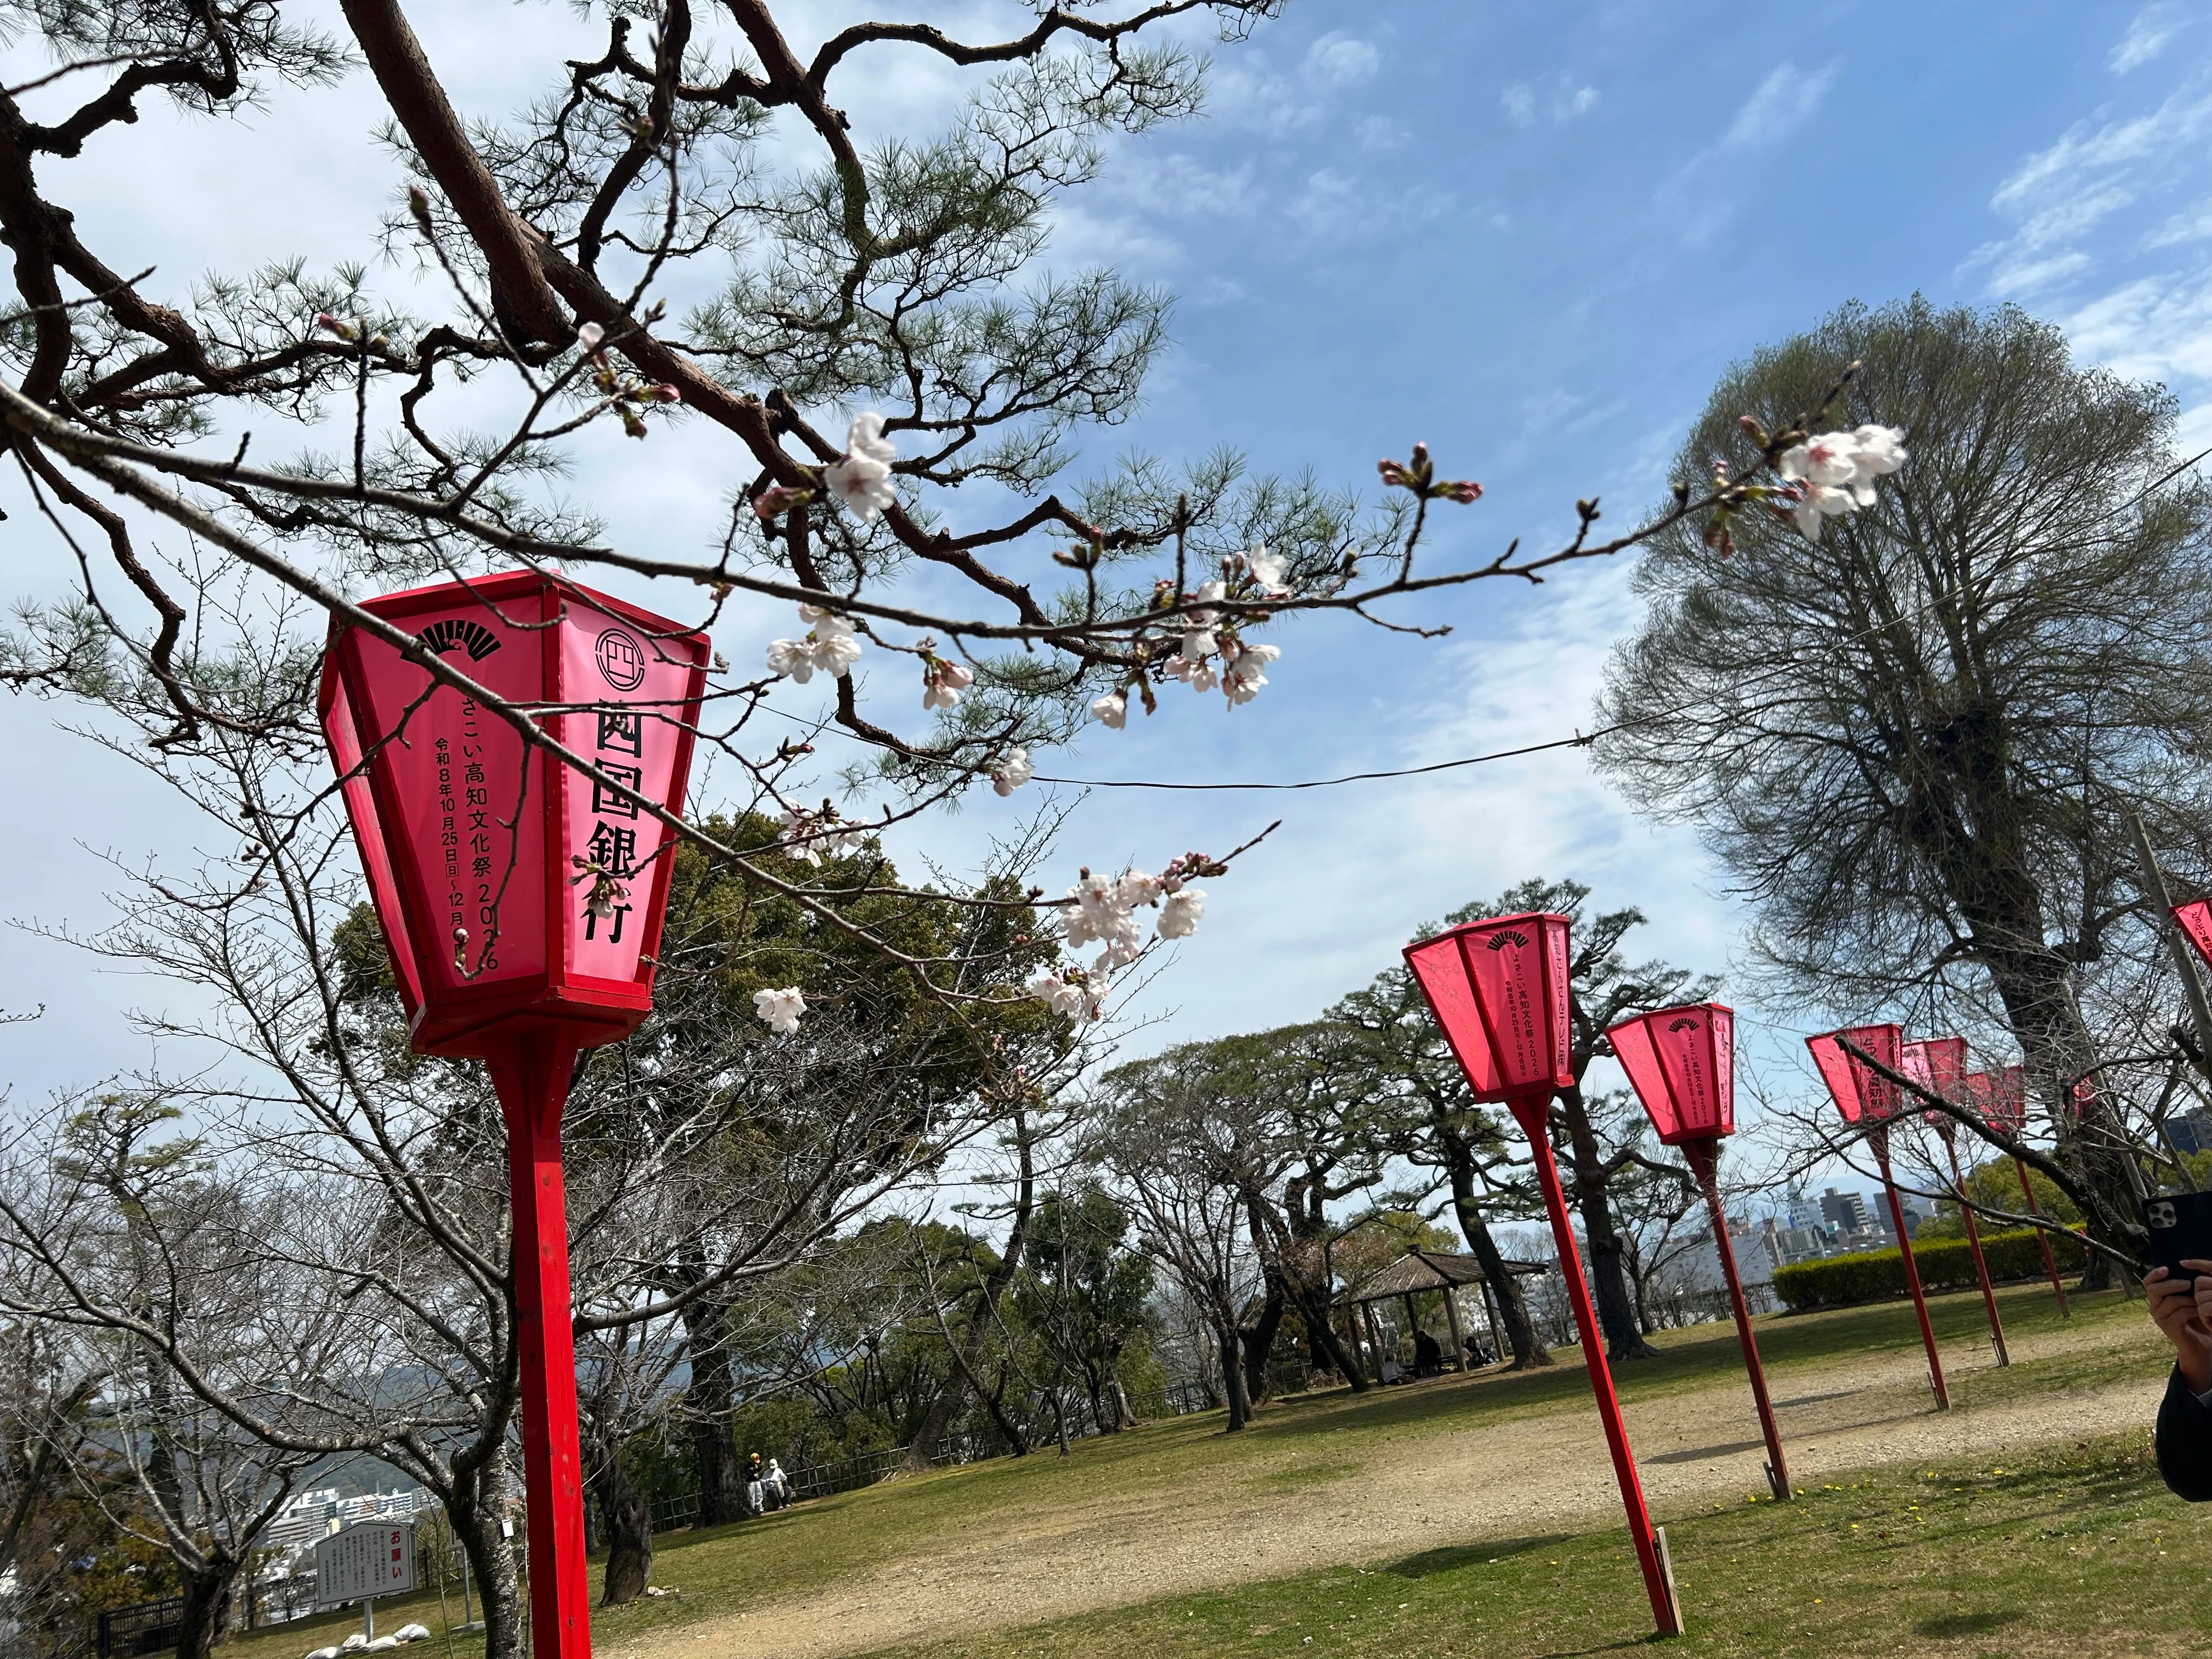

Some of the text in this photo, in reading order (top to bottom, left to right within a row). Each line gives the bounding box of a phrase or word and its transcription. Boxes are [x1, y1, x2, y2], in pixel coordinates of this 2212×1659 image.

[462, 675, 498, 970] さこい高知文化祭206
[580, 698, 642, 944] 四国銀行
[1514, 953, 1539, 1075] よさこい高知文化祭2026
[391, 1530, 402, 1579] お願い
